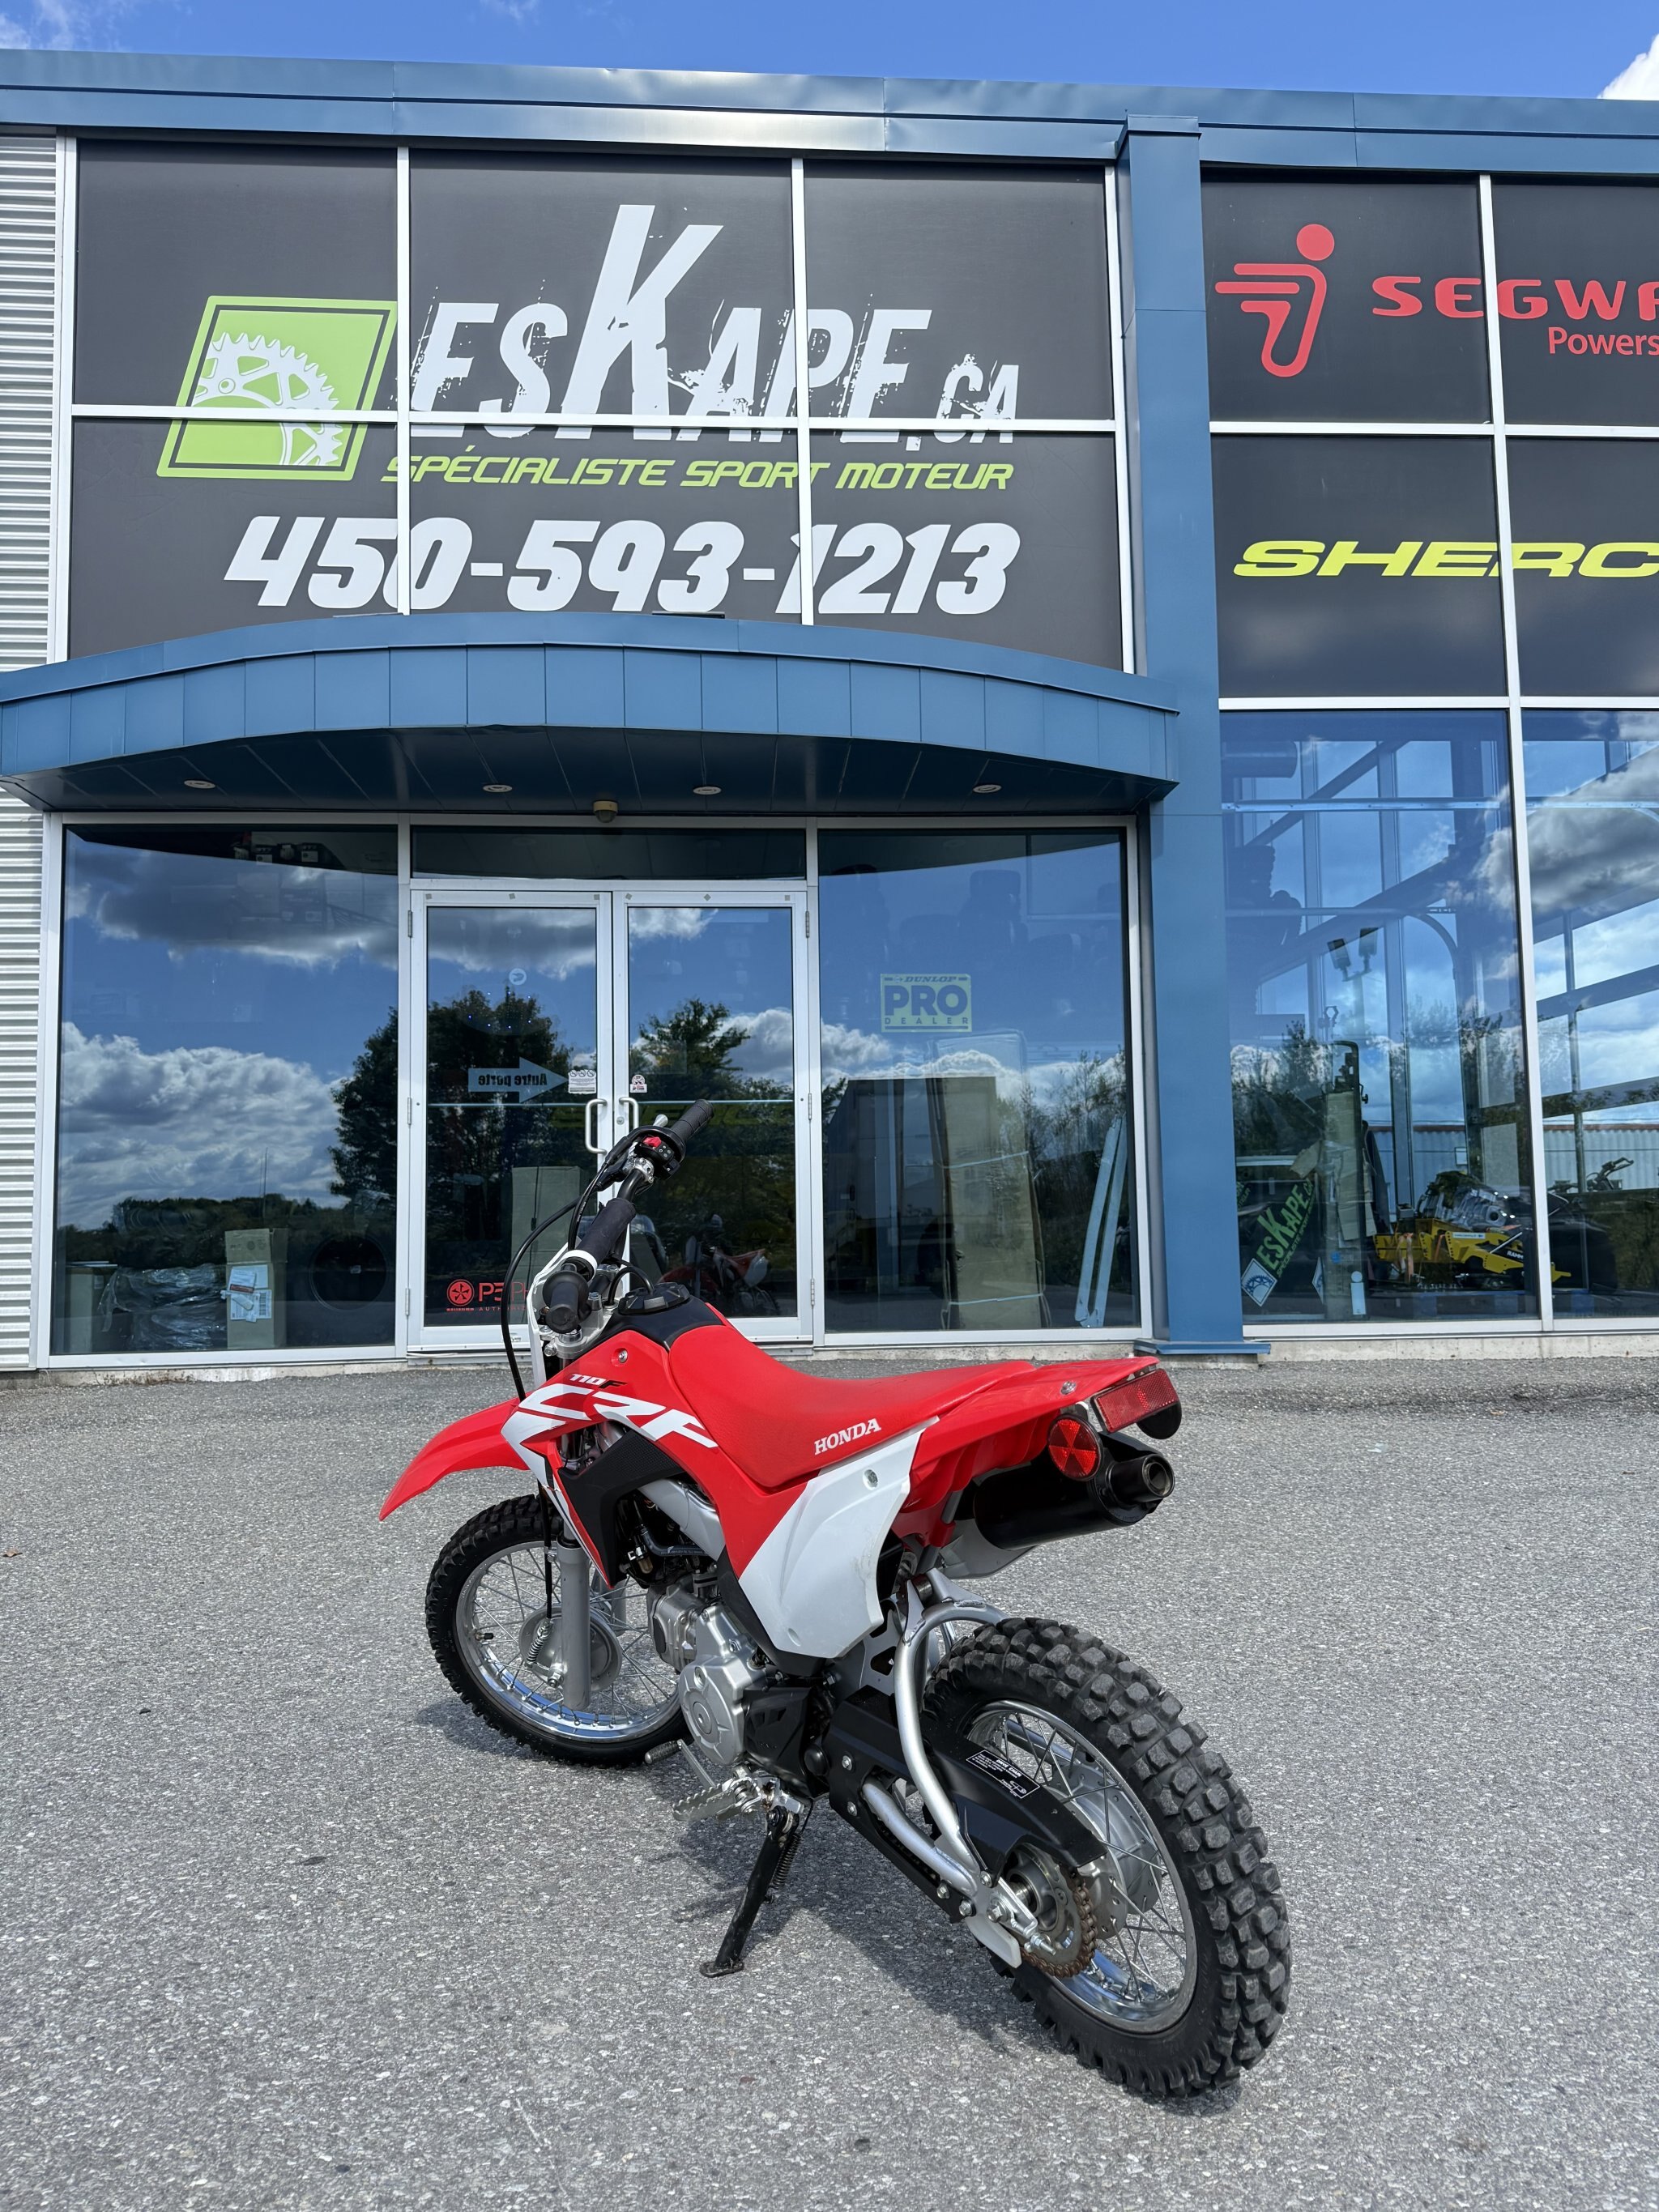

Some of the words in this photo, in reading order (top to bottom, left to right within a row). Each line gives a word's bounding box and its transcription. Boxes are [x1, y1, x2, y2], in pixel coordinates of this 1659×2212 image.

[381, 445, 676, 487] SPÉCIALISTE
[681, 460, 831, 488] SPORT
[835, 462, 1014, 490] MOTEUR
[224, 516, 1020, 615] 450-593-1213
[1234, 540, 1659, 578] SHERC
[885, 984, 968, 1016] PRO
[518, 1383, 719, 1448] CRF
[814, 1417, 881, 1455] HONDA
